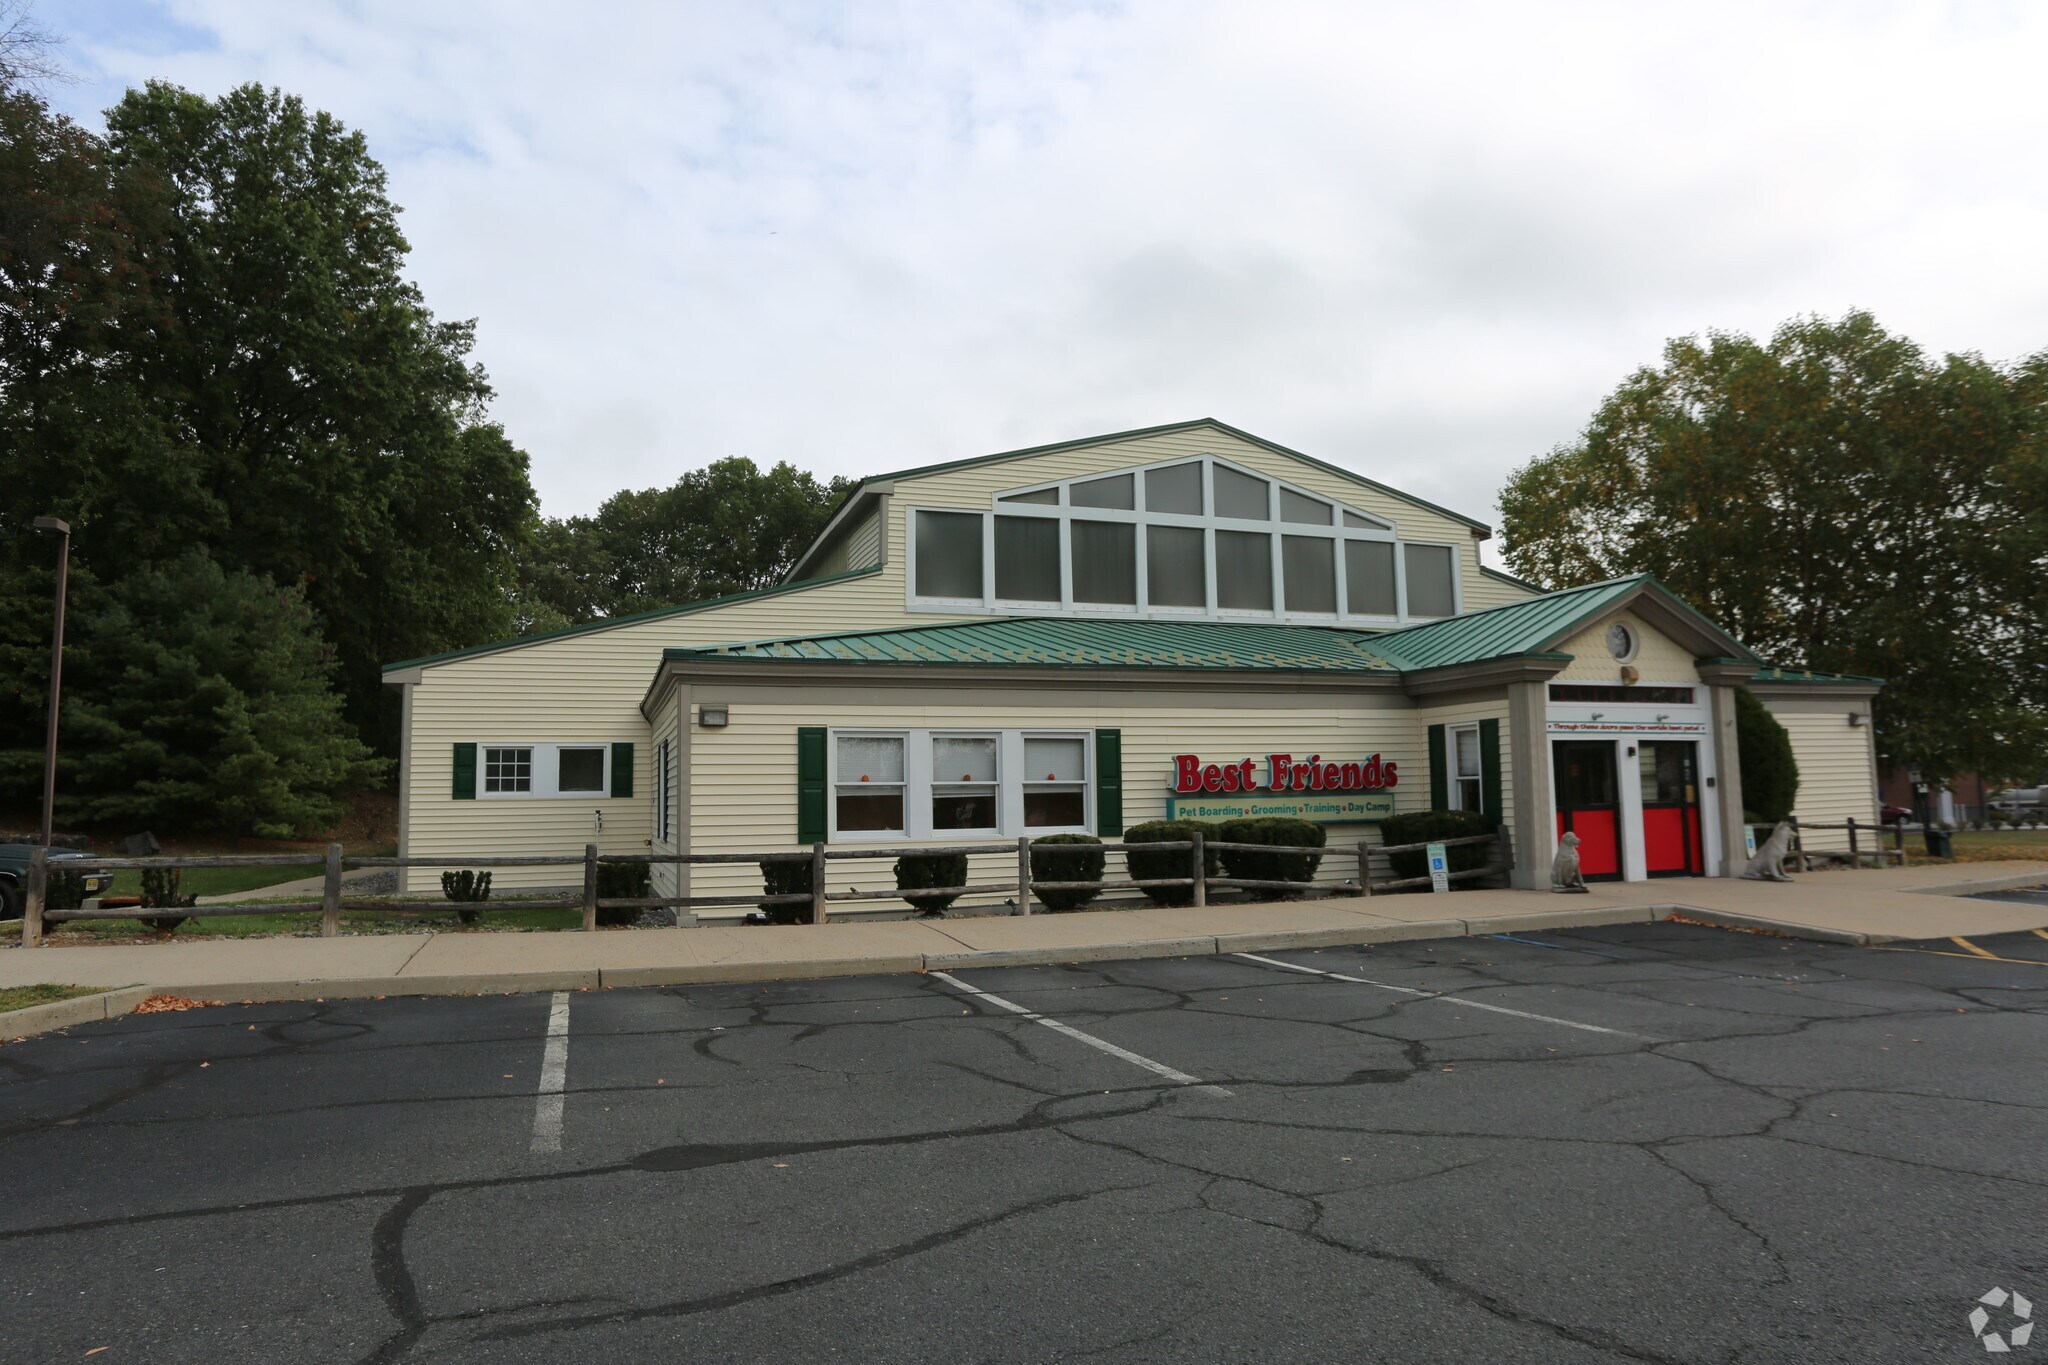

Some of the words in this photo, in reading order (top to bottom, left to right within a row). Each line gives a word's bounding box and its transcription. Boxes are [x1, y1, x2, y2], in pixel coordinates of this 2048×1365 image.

[1553, 723, 1579, 731] Through
[1173, 753, 1257, 792] Best
[1267, 753, 1398, 791] Friends
[1179, 807, 1197, 817] Pet
[1199, 805, 1243, 818] Boarding
[1251, 804, 1298, 816] Grooming
[1303, 802, 1341, 815] Training
[1347, 802, 1365, 814] Day
[1365, 801, 1391, 813] Camp
